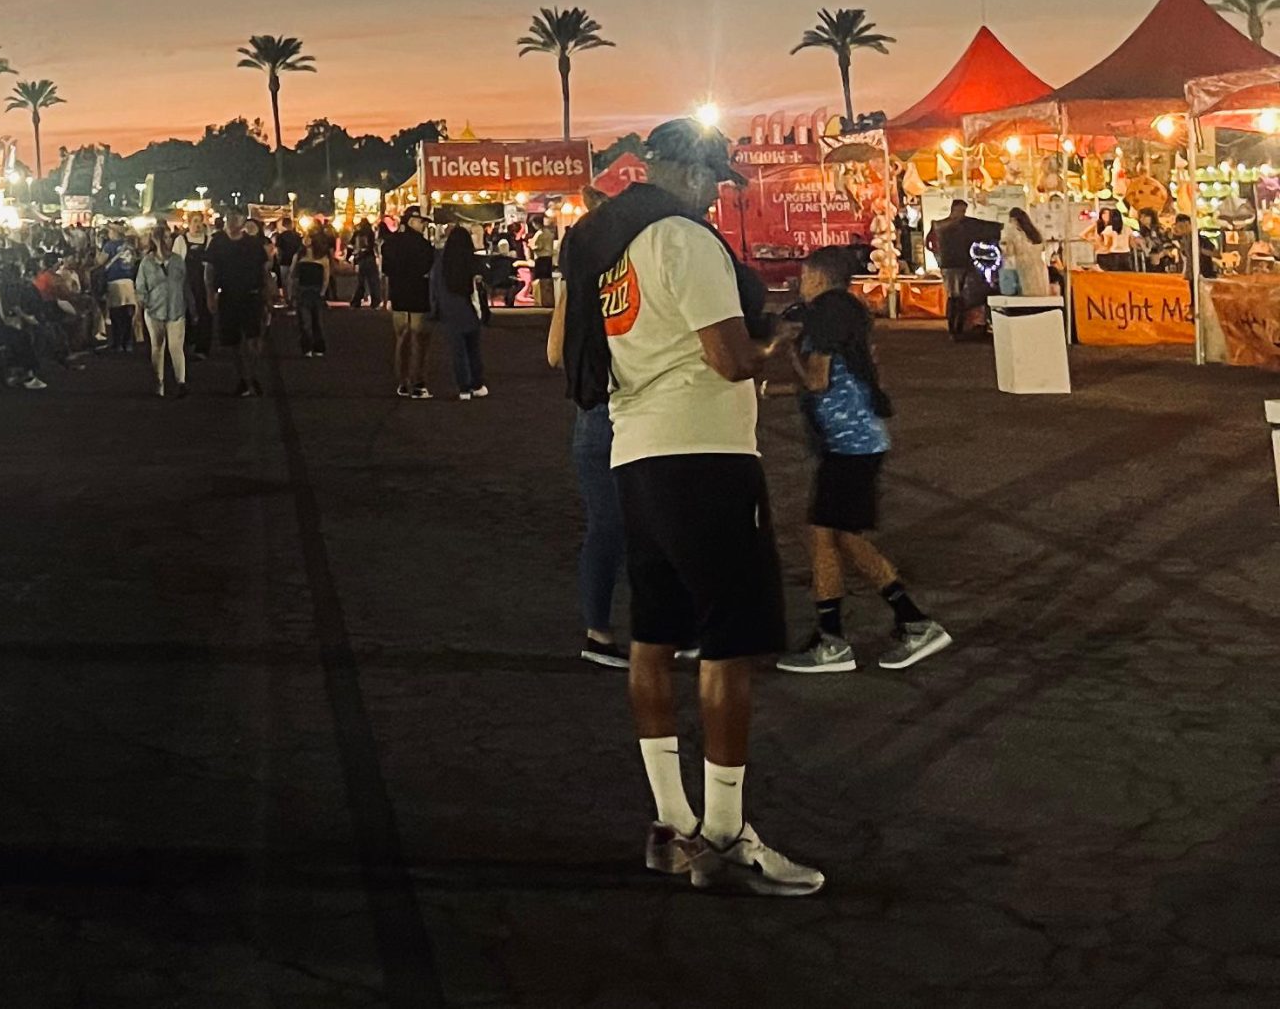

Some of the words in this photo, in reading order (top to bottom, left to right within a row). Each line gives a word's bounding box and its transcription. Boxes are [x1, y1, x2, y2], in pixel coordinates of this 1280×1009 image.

[429, 156, 499, 177] Tickets
[512, 156, 584, 177] Tickets
[806, 201, 851, 213] NETWOR
[810, 230, 850, 246] Mobil
[599, 280, 629, 318] RUZ
[1087, 291, 1153, 330] Night
